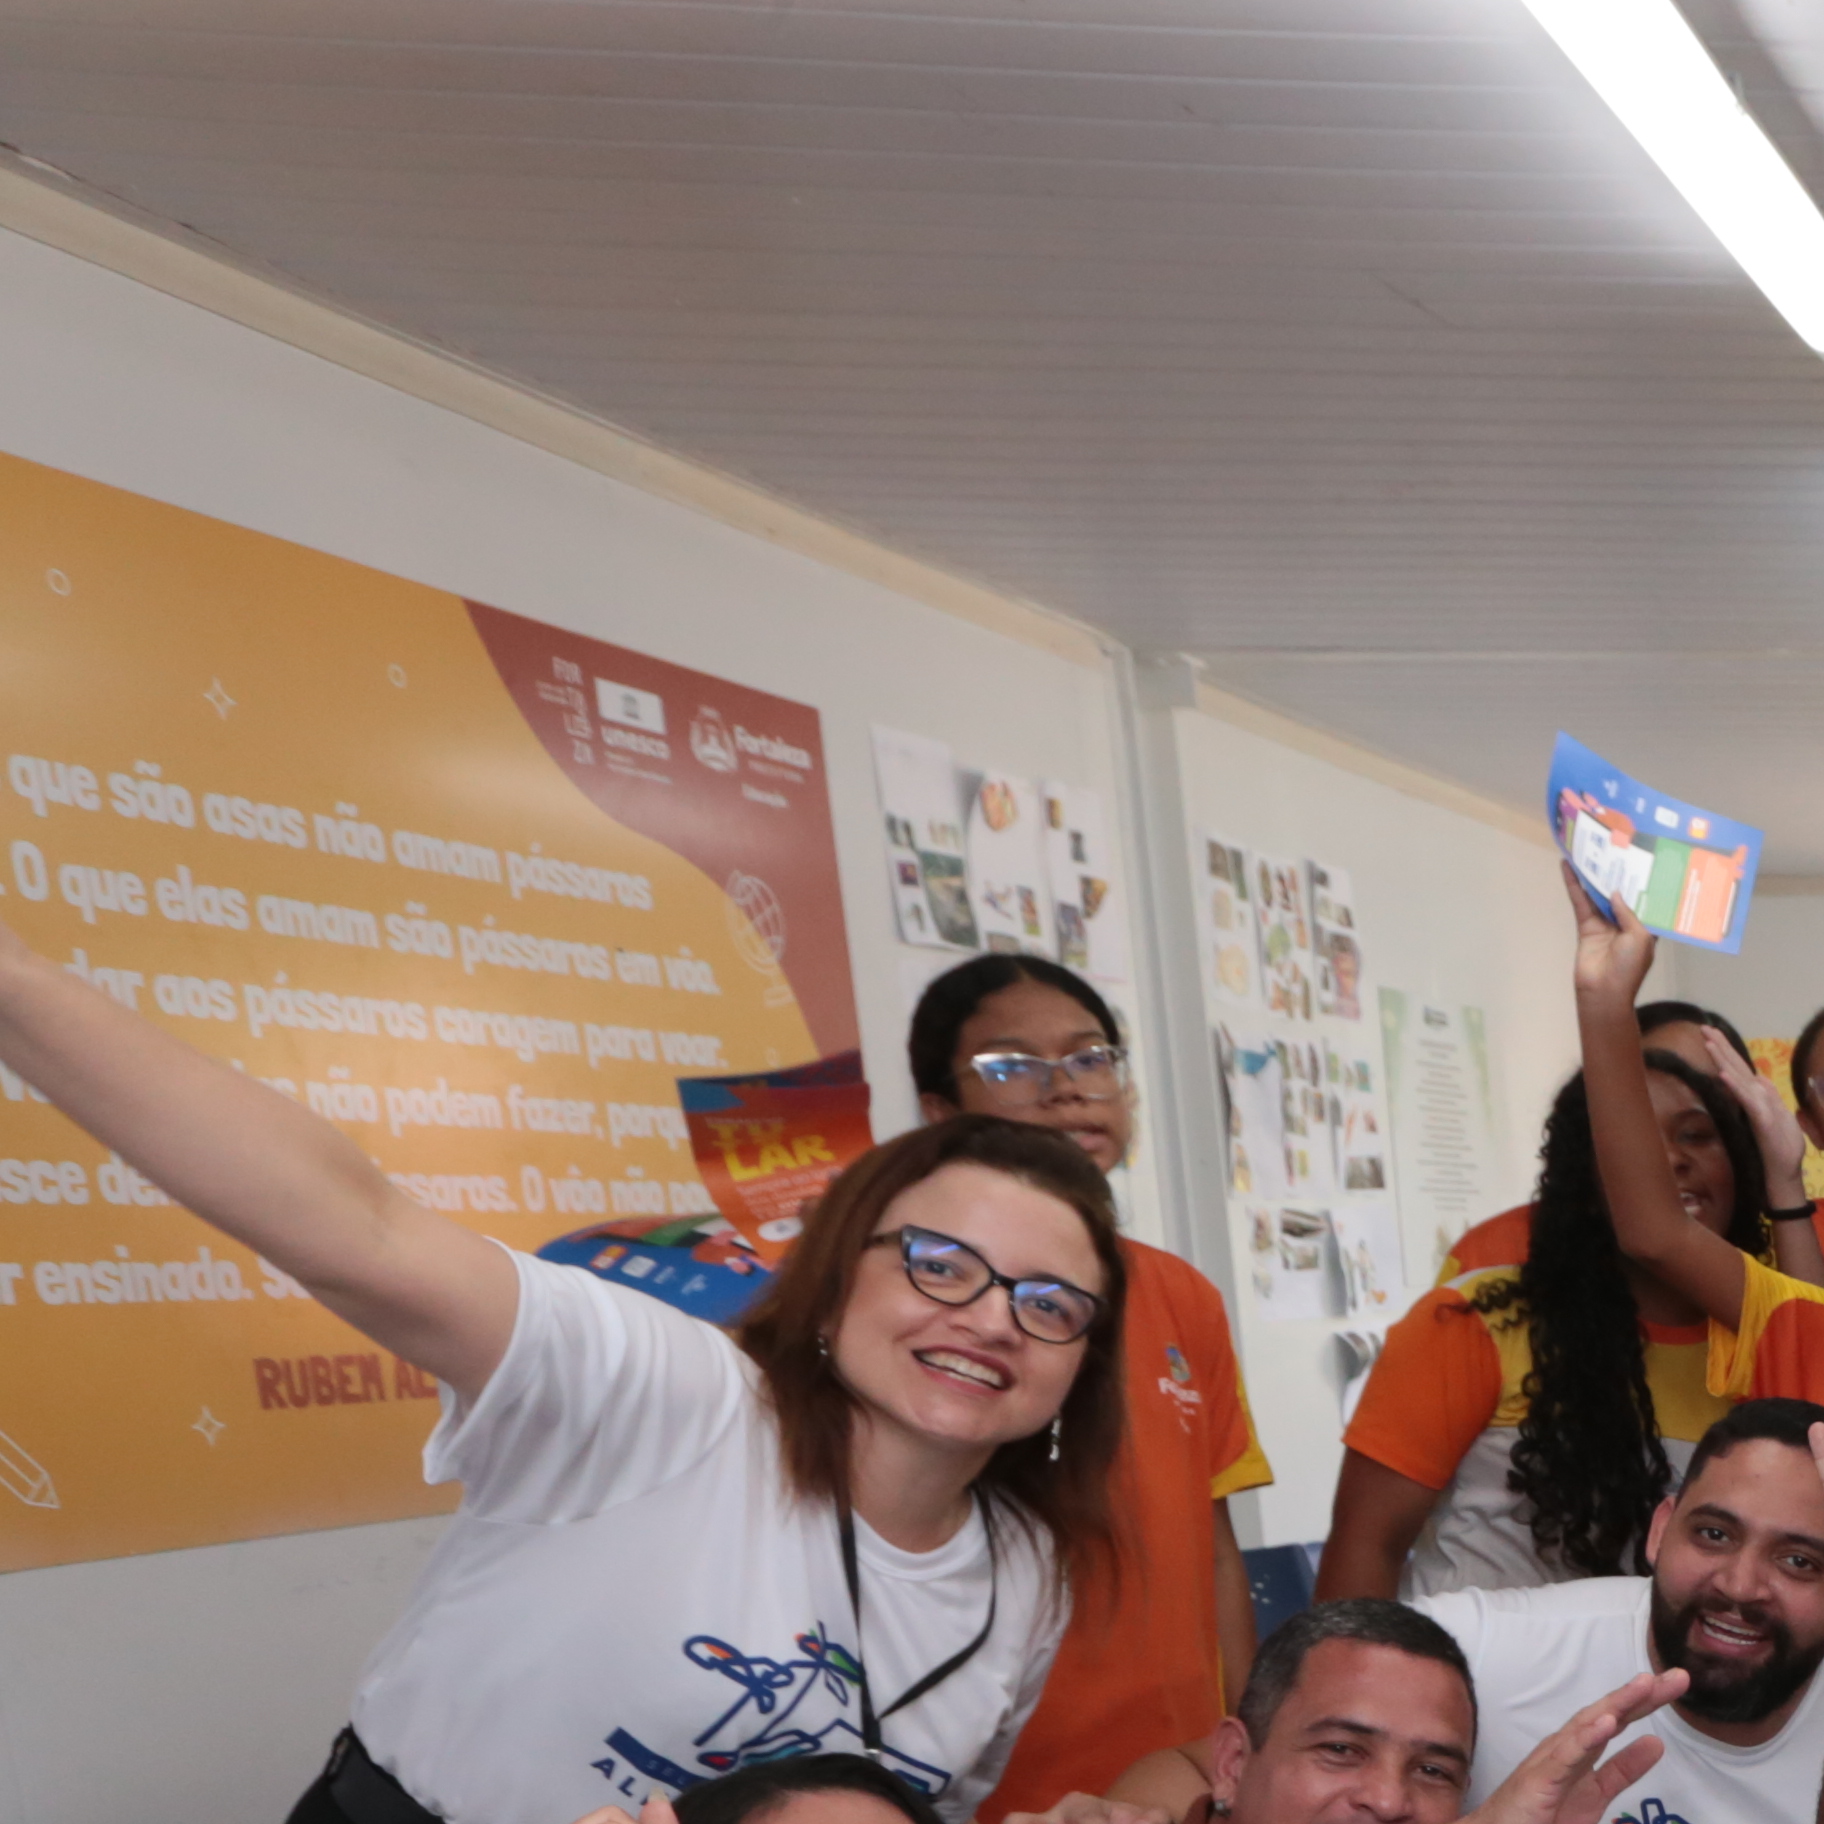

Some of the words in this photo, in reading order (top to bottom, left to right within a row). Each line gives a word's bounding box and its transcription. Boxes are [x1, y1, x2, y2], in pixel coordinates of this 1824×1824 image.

[8, 753, 101, 818] que
[108, 758, 197, 829] são
[202, 792, 308, 849] asas
[312, 801, 388, 864] não
[391, 829, 502, 884] amam
[506, 841, 655, 911] pássaros
[11, 839, 49, 901] O
[58, 863, 148, 925] que
[155, 864, 250, 931] elas
[256, 894, 380, 949] amam
[384, 900, 453, 959] são
[457, 914, 612, 982] pássaros
[615, 951, 663, 988] em
[153, 974, 238, 1022] aos
[242, 970, 428, 1040] pássaros
[433, 1004, 580, 1065] coragem
[584, 1022, 656, 1069] para
[659, 1029, 728, 1069] voar.
[304, 1065, 379, 1124] não
[384, 1078, 503, 1138] podem
[0, 1157, 90, 1206] sce
[521, 1165, 545, 1213] O
[609, 1166, 663, 1214] não
[726, 1134, 836, 1182] LAR
[34, 1244, 254, 1306] ensinado.
[252, 1353, 387, 1411] RUBEM
